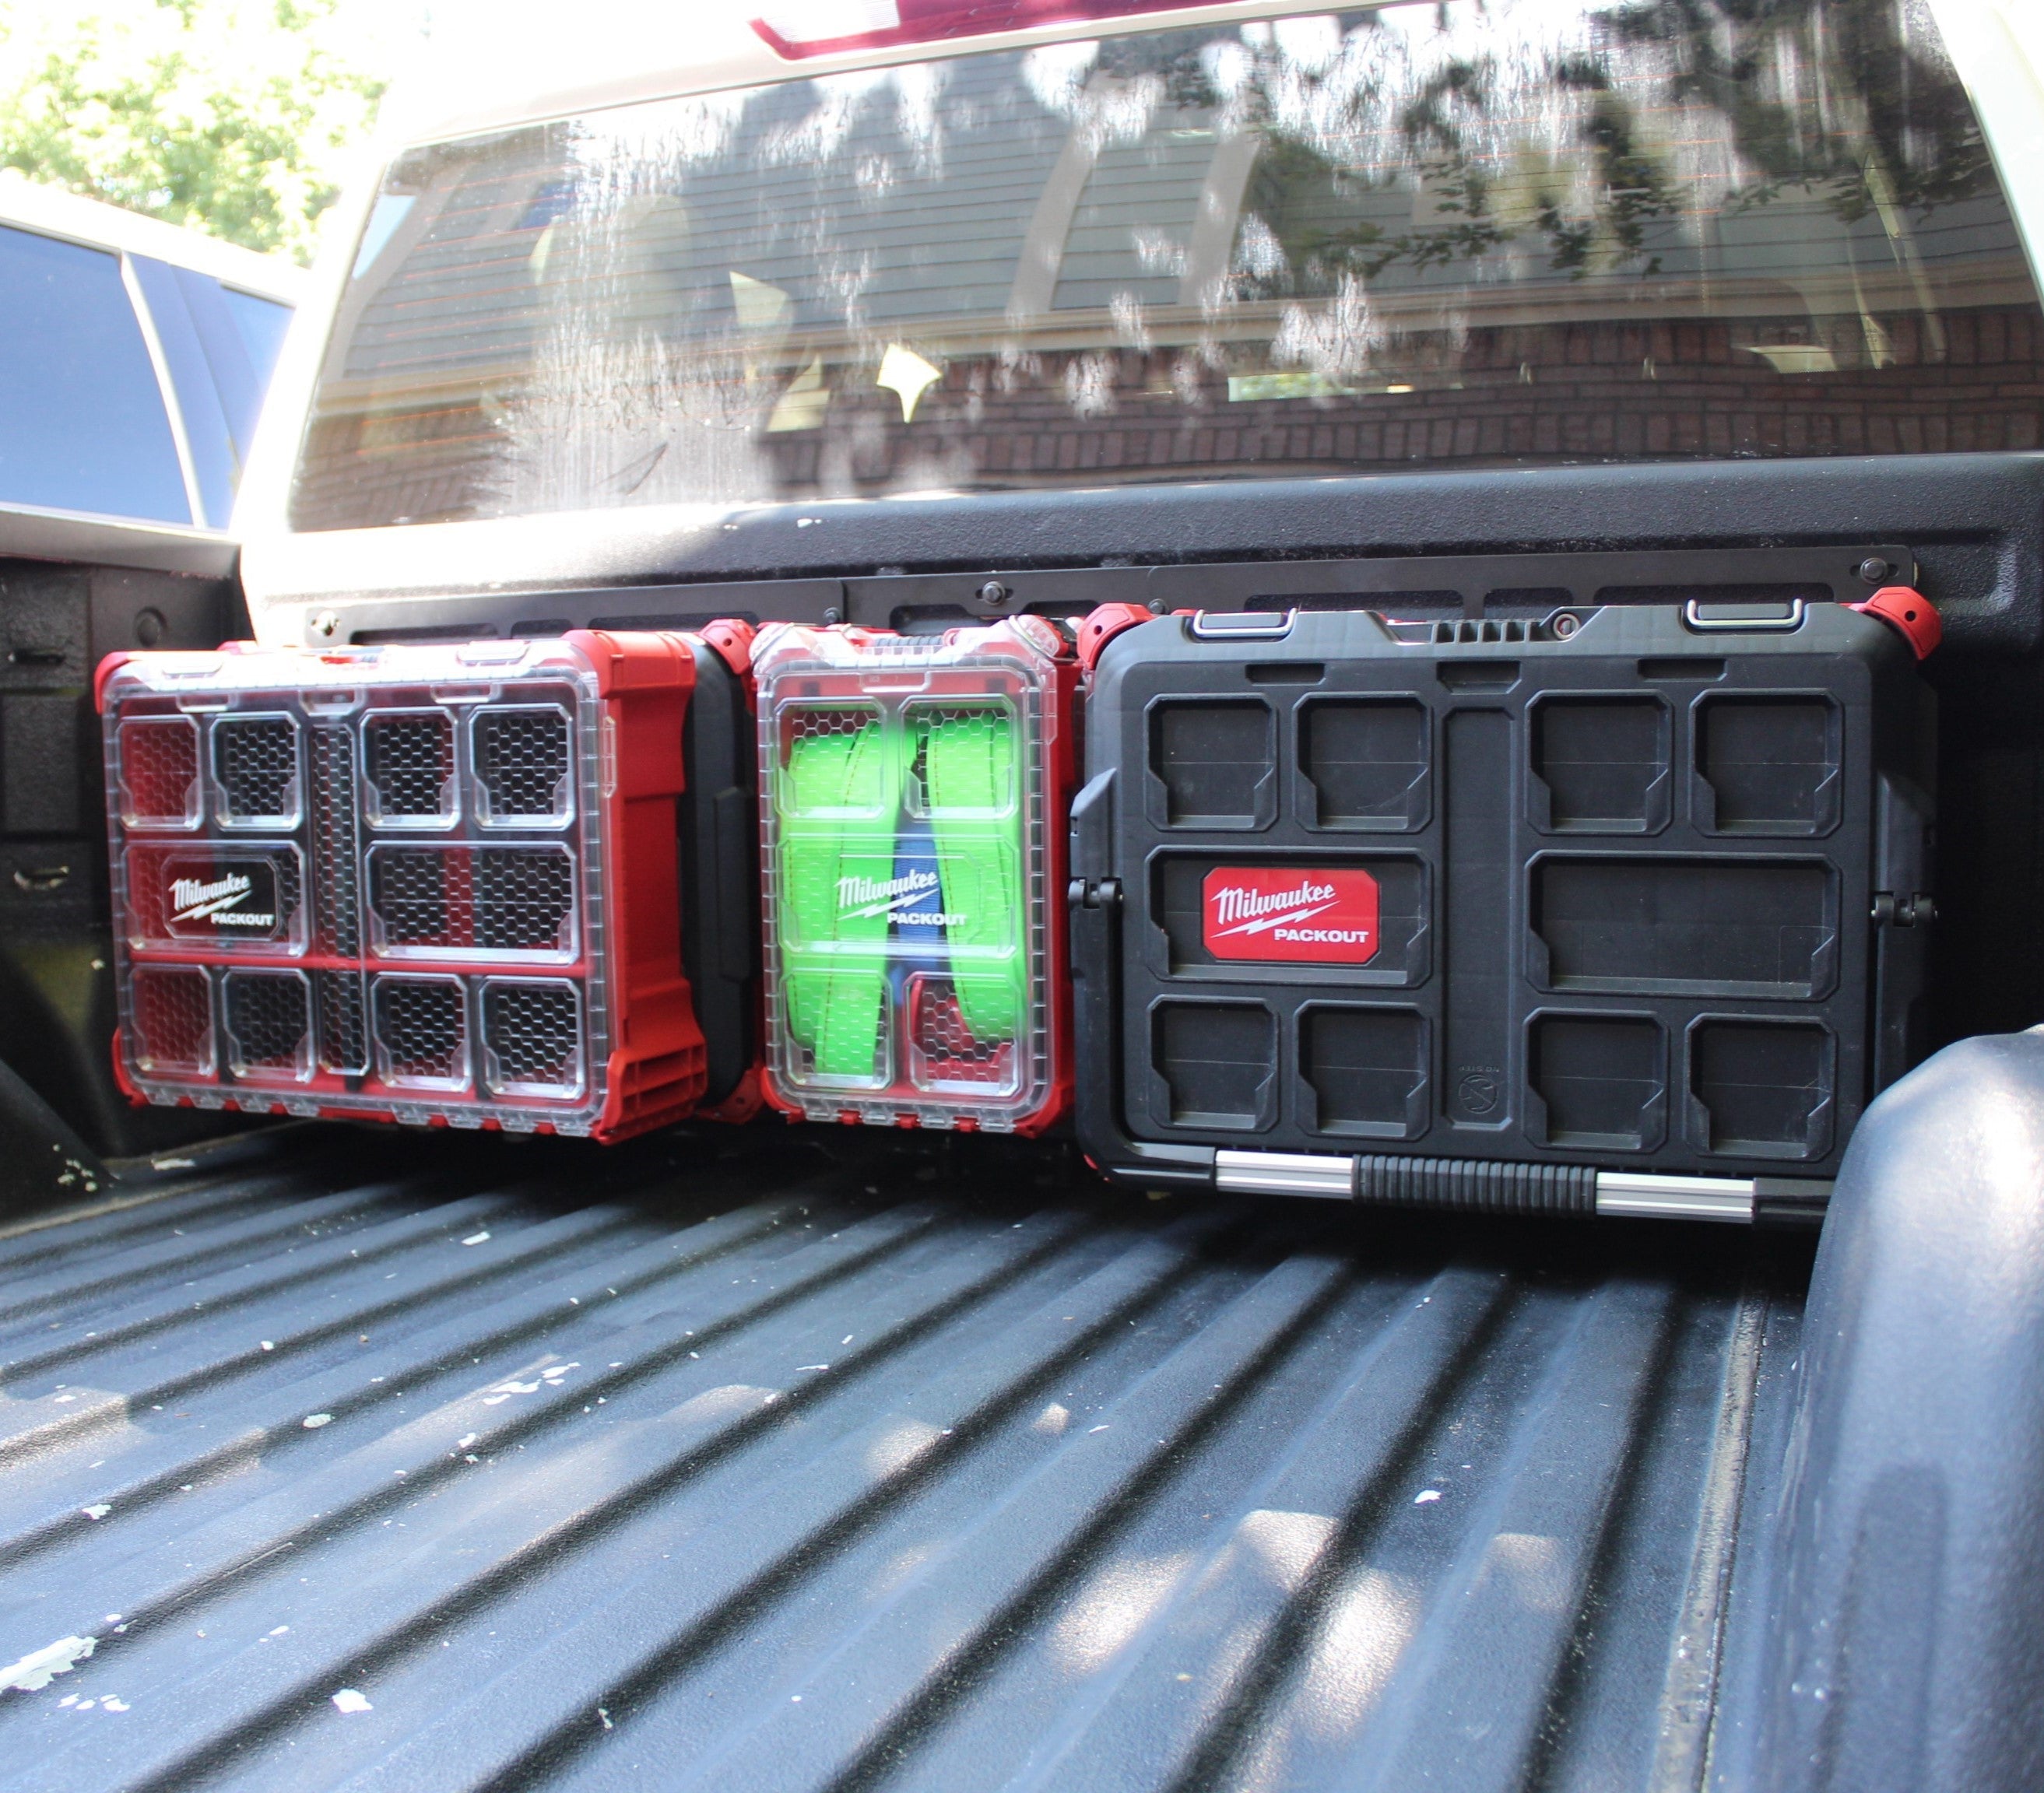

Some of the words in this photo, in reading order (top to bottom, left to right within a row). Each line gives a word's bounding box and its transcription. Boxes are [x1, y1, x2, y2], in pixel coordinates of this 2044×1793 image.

[168, 872, 251, 911] Milwaukee
[834, 868, 939, 909] Milwaukee
[1210, 880, 1336, 925] Milwaukee
[210, 912, 275, 926] PACKOUT
[887, 912, 967, 926] PACKOUT
[1274, 928, 1369, 943] PACKOUT
